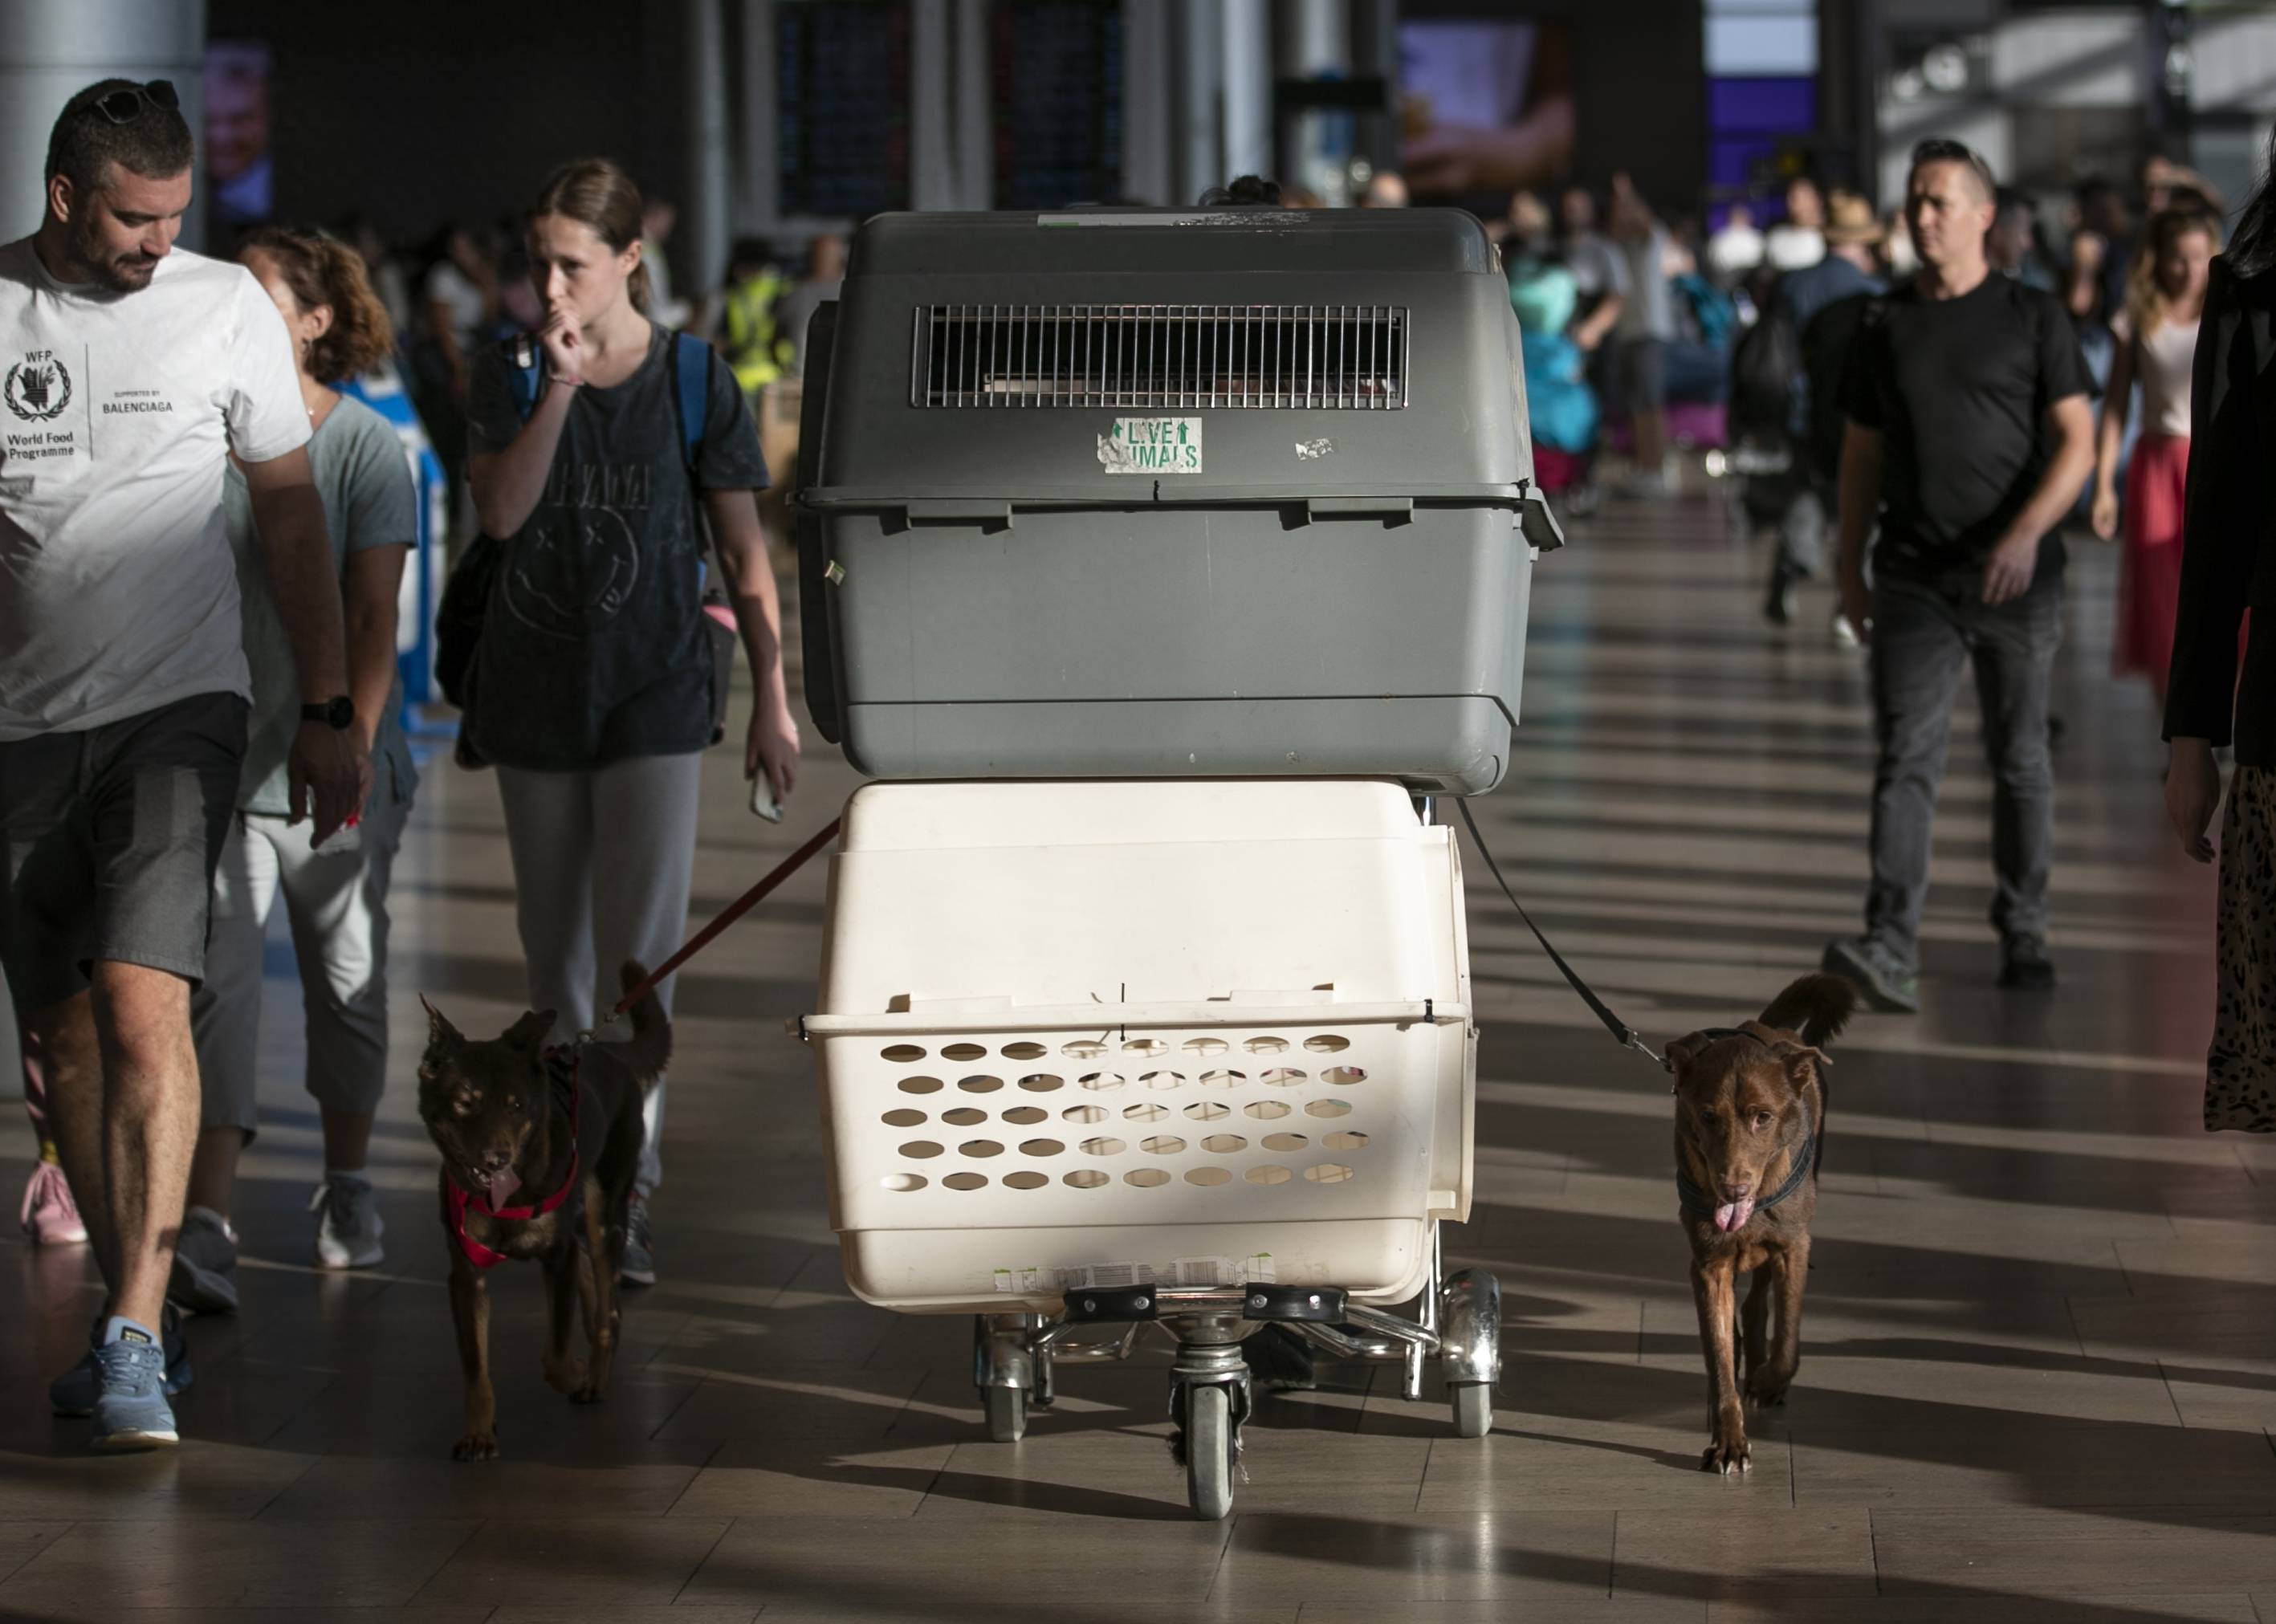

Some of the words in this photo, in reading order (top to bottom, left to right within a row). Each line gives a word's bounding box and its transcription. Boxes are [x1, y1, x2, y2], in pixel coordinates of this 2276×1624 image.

[26, 350, 53, 363] WFP
[103, 401, 173, 414] BALENCIAGA
[7, 433, 43, 446] World
[47, 431, 74, 443] Food
[9, 446, 75, 461] Programme
